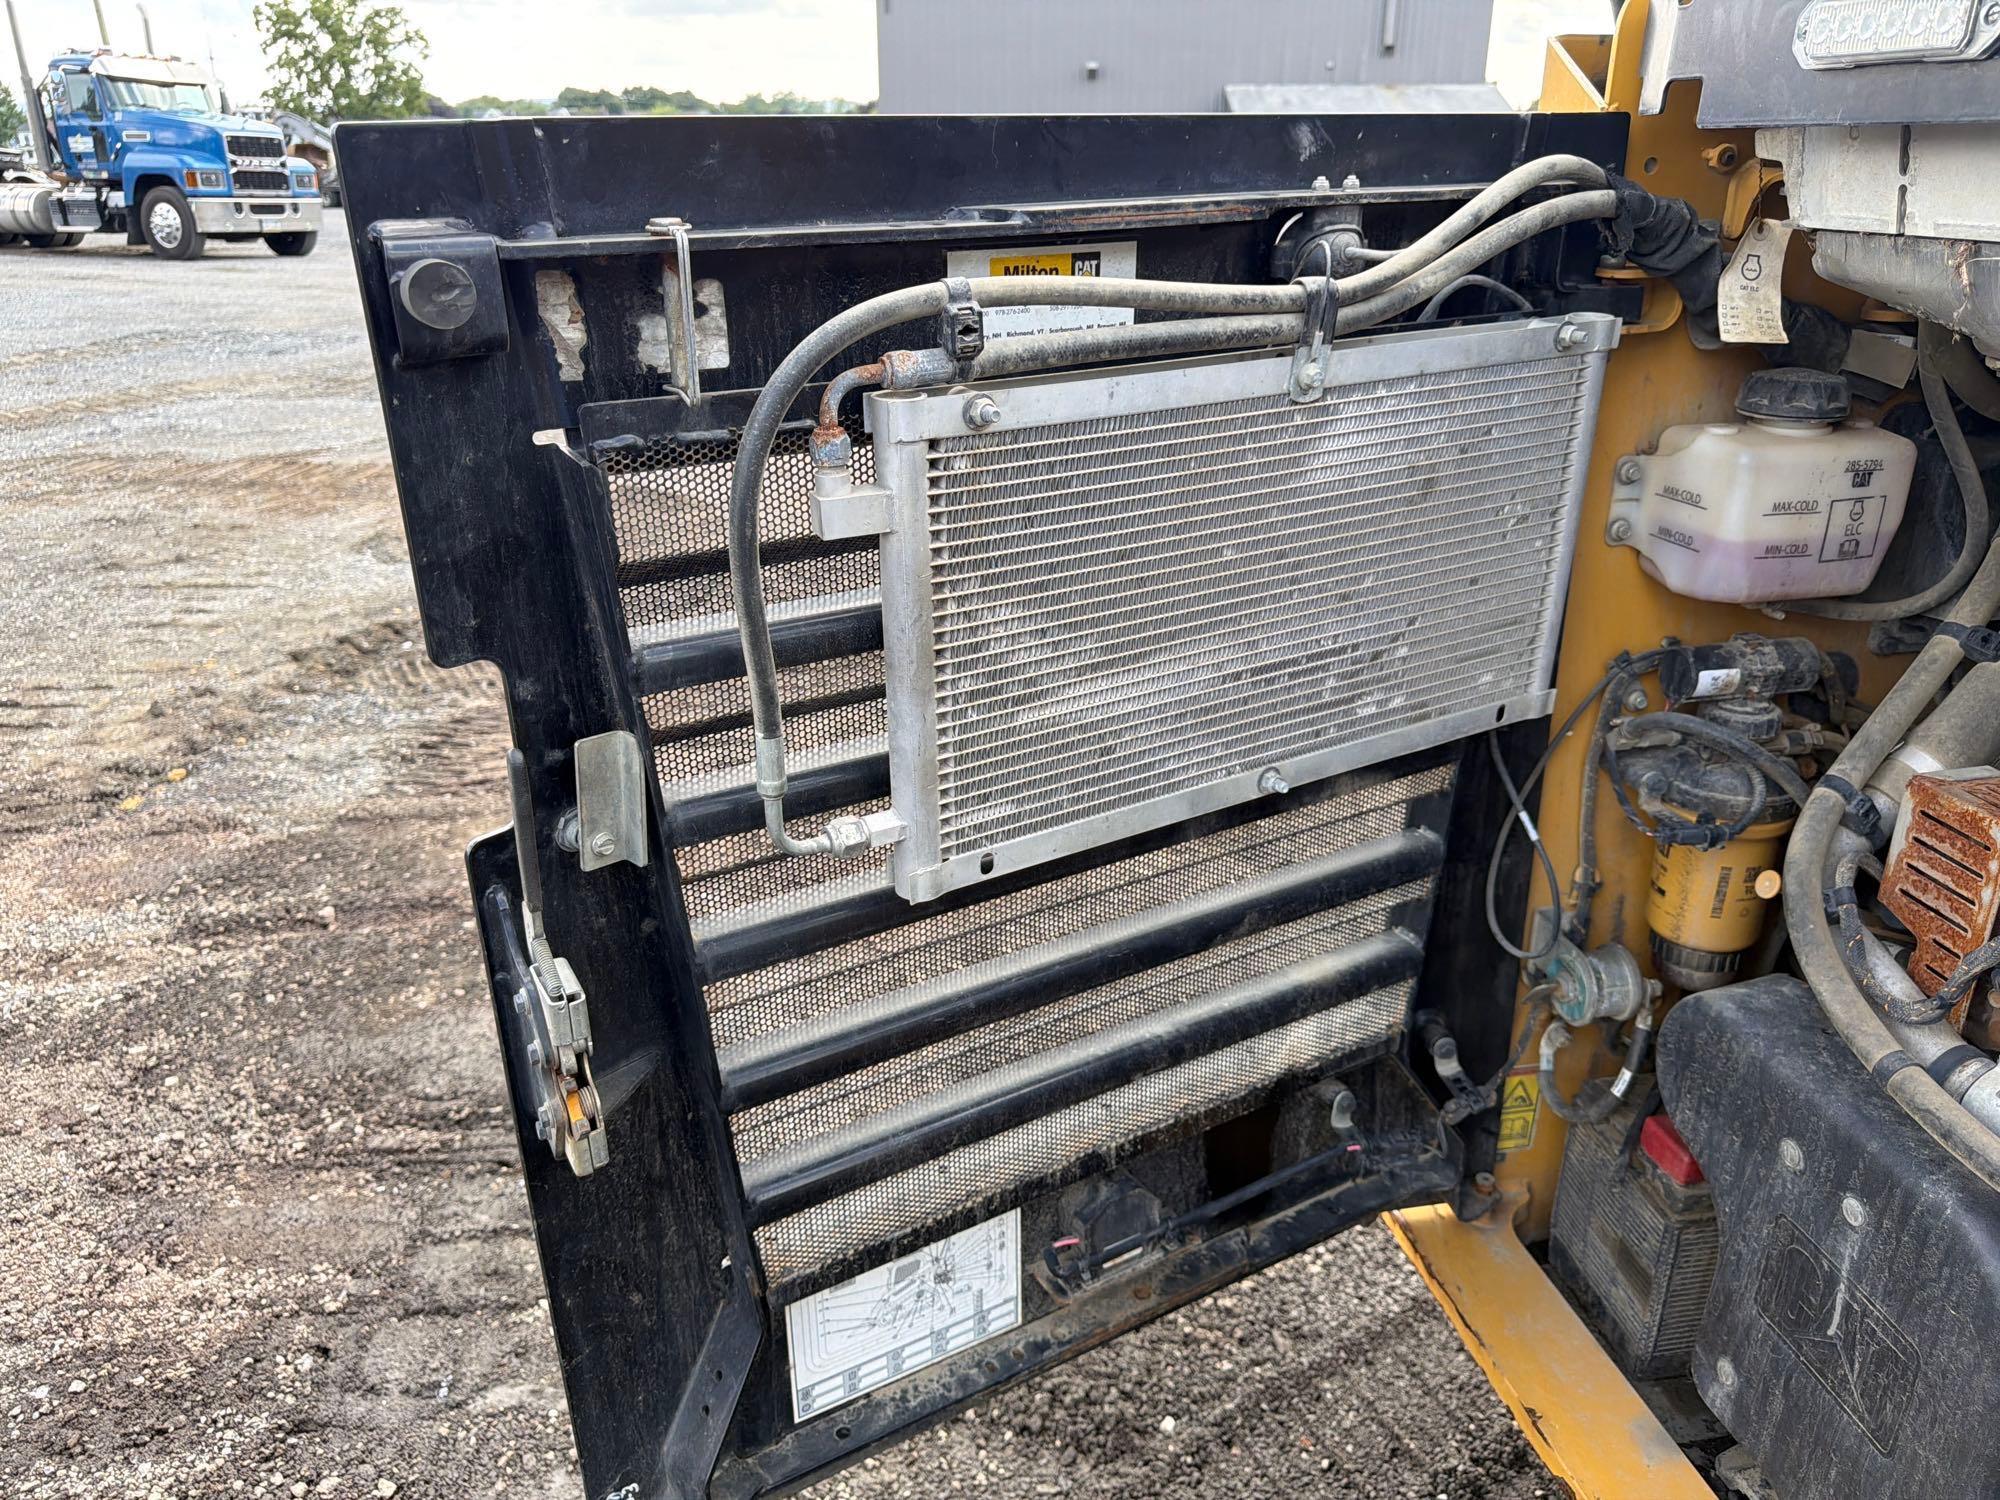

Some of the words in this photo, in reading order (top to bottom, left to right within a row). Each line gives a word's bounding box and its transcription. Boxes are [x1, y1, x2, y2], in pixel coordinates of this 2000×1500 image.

[1003, 264, 1060, 276] Milton
[1074, 260, 1098, 276] CAT
[1845, 460, 1883, 470] 285-5794
[1851, 471, 1874, 488] CAT
[1662, 485, 1702, 504] MAX-COLD
[1771, 500, 1819, 513] MAX-COLD
[1656, 526, 1694, 546] MIN-COLD
[1844, 522, 1864, 536] ELC
[1764, 543, 1809, 555] MIN-COLD
